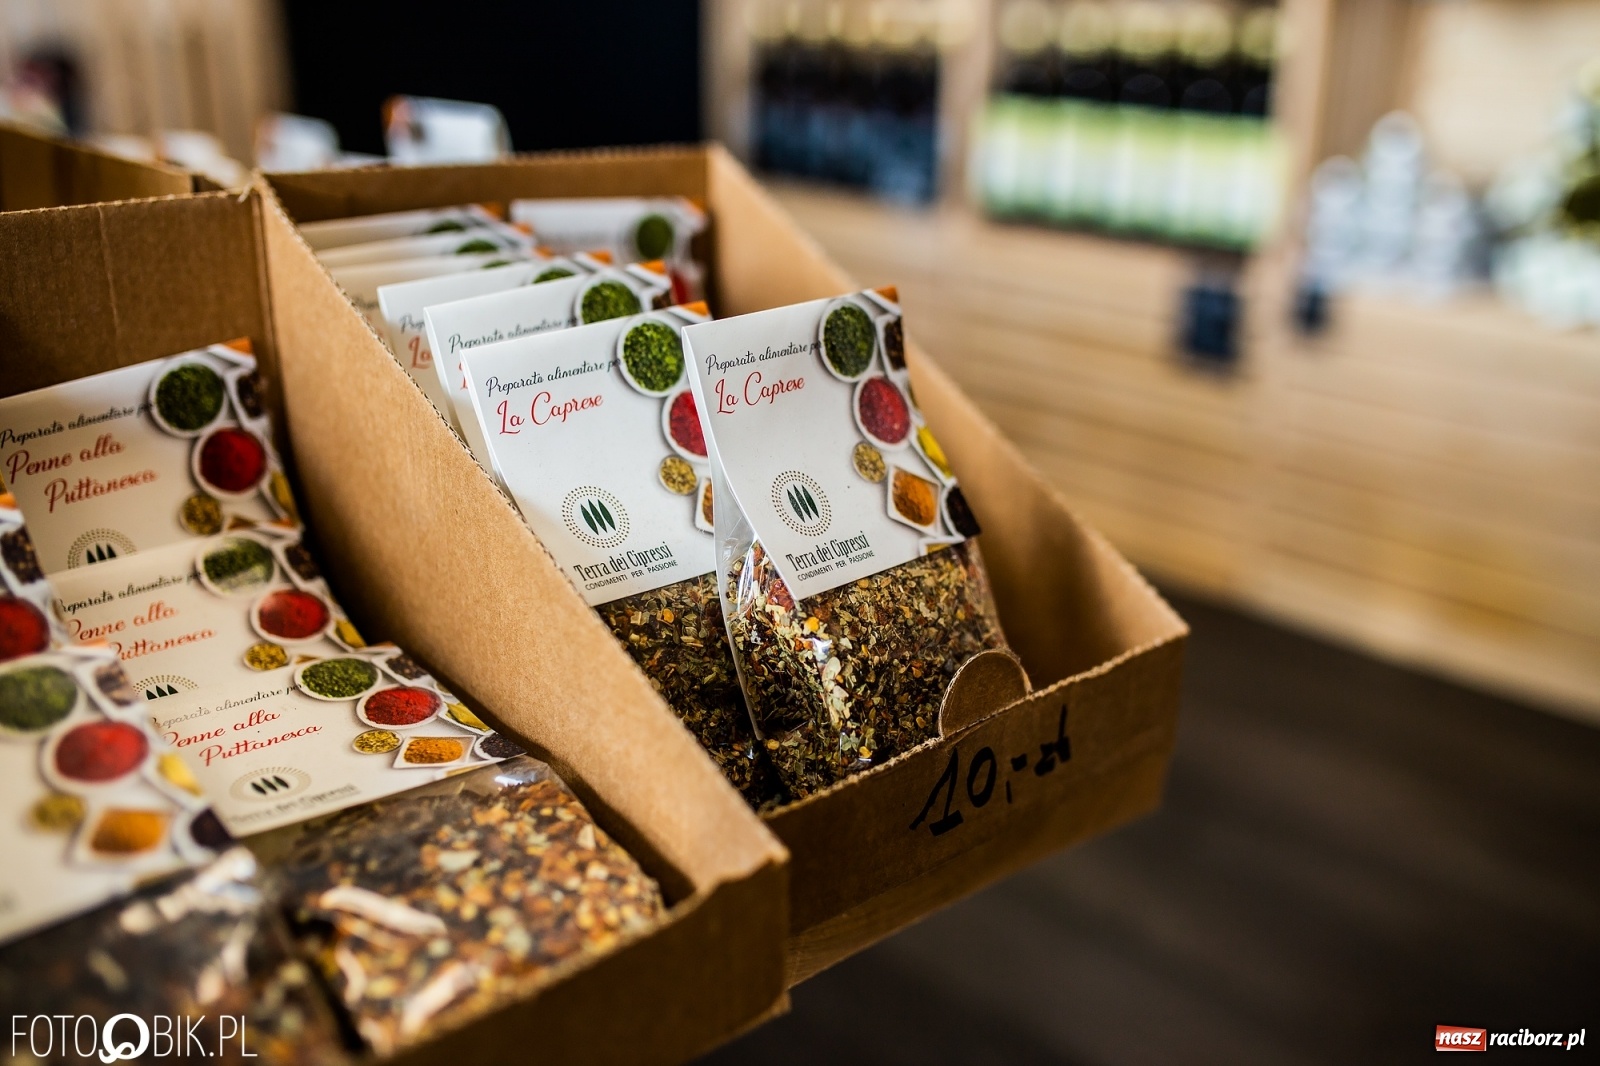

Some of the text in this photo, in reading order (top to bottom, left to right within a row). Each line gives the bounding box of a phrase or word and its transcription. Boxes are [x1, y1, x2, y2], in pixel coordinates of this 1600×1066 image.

[486, 371, 544, 397] Preparato
[547, 360, 605, 383] alimentare
[705, 350, 757, 375] Preparato
[759, 342, 808, 362] alimentare
[496, 391, 603, 435] La Caprese
[714, 371, 805, 414] La Caprese
[0, 419, 64, 448] Preparato
[68, 405, 134, 430] alimentare
[6, 432, 127, 484] Penne alla
[44, 468, 158, 513] Puttanesca
[573, 541, 673, 582] Terra dei Cipressi
[786, 531, 870, 572] Terra dei Cipressi
[797, 550, 875, 582] CONDIMENTI PER PASSIONE
[585, 559, 678, 591] CONDIMENTI PER PASSIONE
[133, 600, 180, 626] alla
[216, 691, 284, 713] alimentare
[233, 709, 281, 732] alla
[199, 724, 323, 767] Puttanesca
